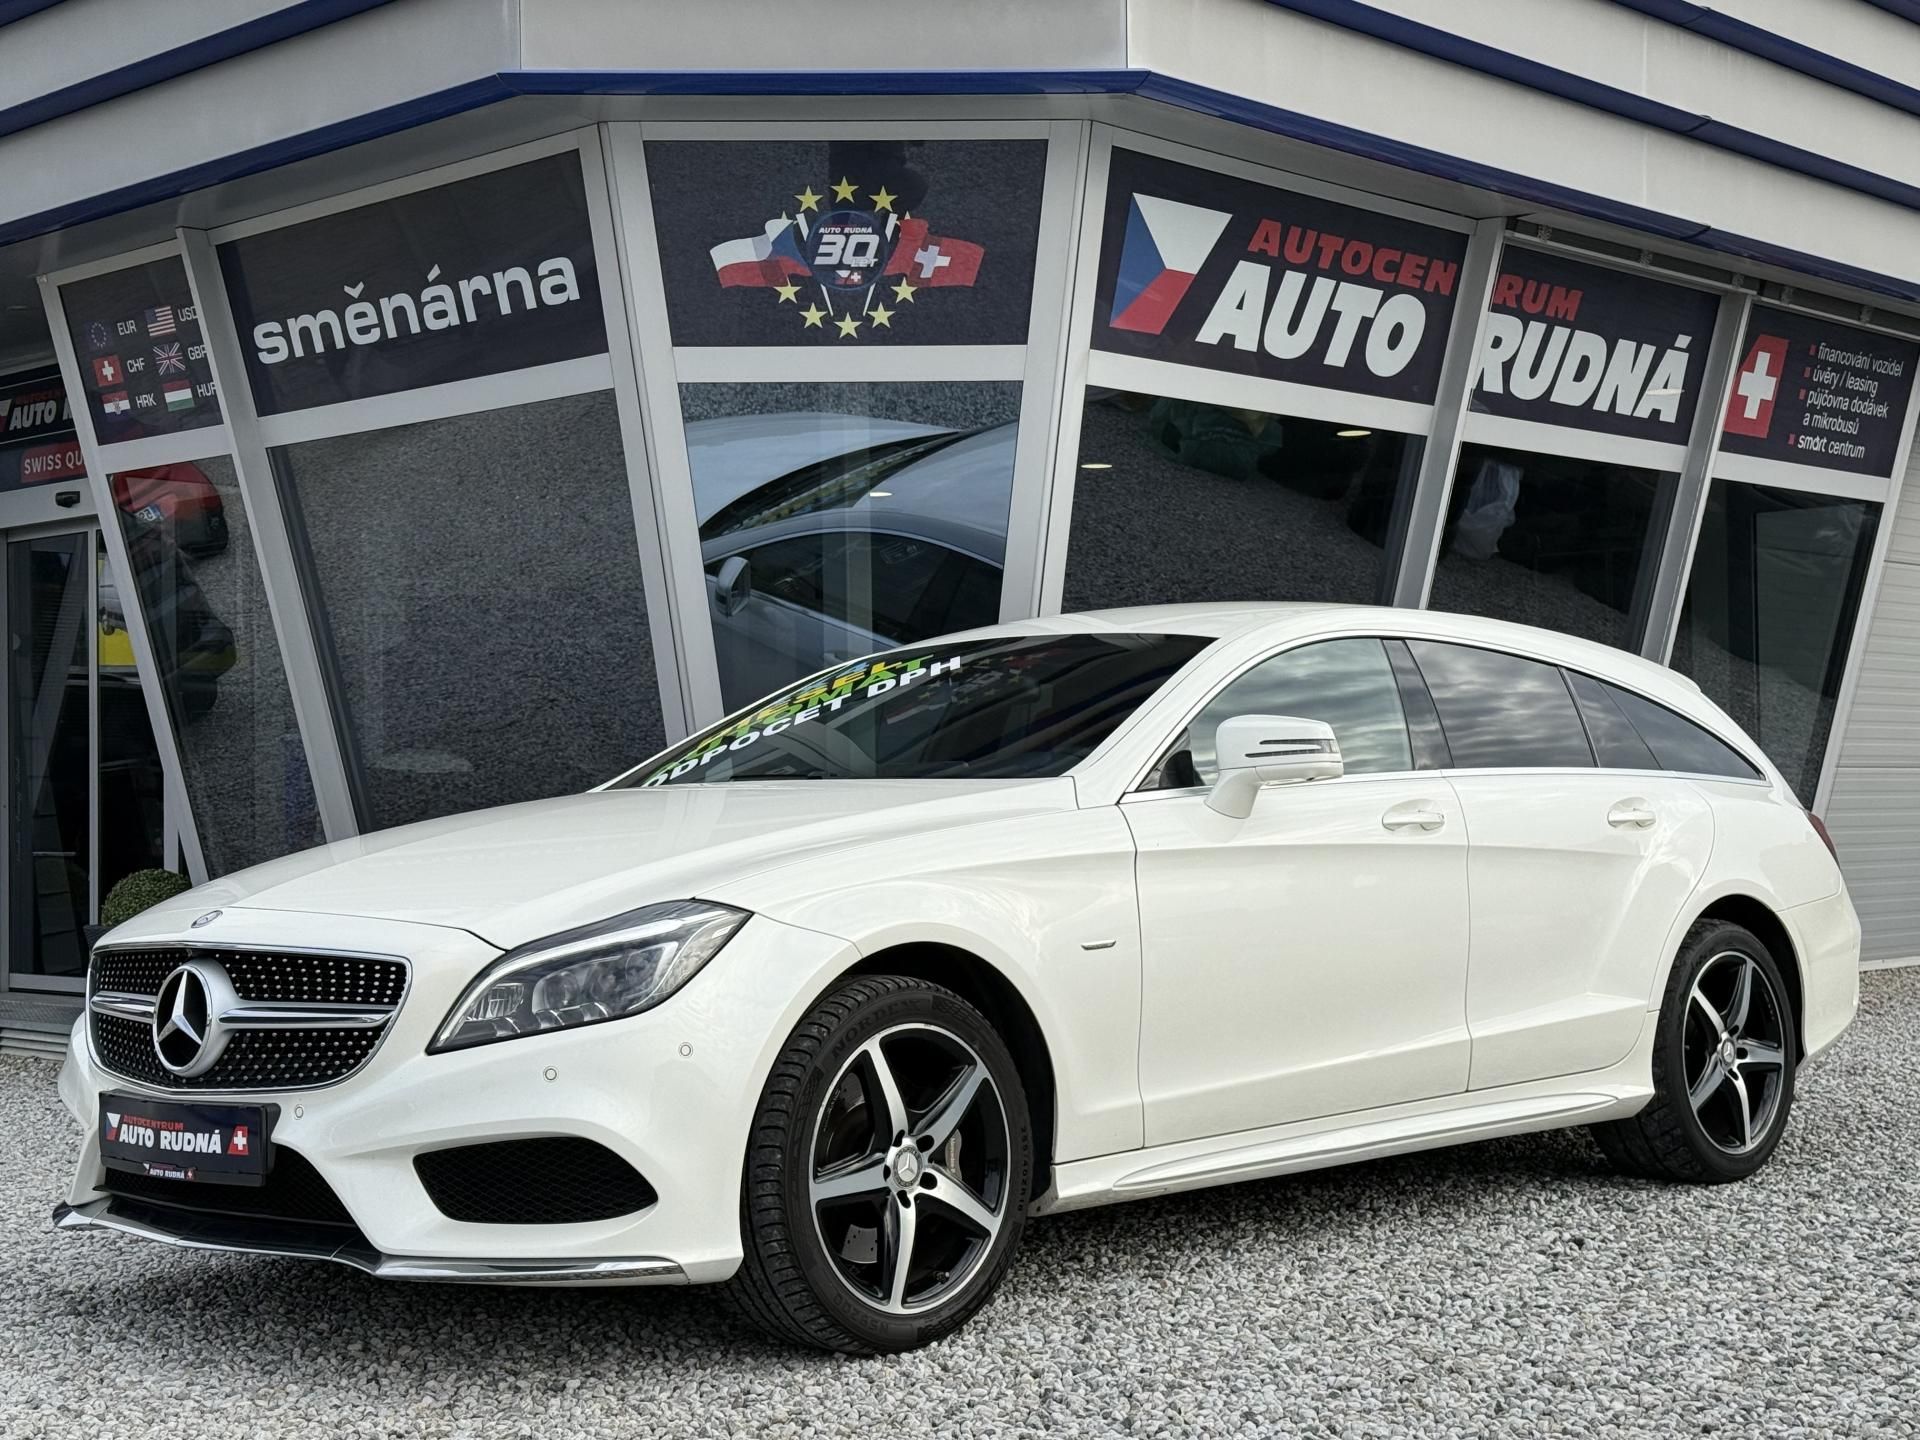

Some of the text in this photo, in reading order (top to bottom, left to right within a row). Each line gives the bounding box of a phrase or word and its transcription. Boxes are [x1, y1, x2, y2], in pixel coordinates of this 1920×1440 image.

[819, 226, 842, 234] AUTO
[813, 234, 880, 265] 30
[1248, 218, 1458, 296] AUTOCEN
[178, 305, 198, 322] USD
[253, 256, 581, 365] směnárna
[117, 320, 137, 336] EUR
[1195, 259, 1693, 425] AUTO RUDNÁ
[126, 358, 146, 373] CHF
[1818, 342, 1904, 377] financování vozidel
[1812, 365, 1840, 390] úvěry
[1846, 371, 1879, 398] leasing
[136, 393, 157, 408] HRK
[1806, 387, 1889, 418] půjčovna dodávek
[9, 400, 57, 431] AUTO
[1803, 412, 1860, 435] a mikrobusů
[1828, 440, 1866, 459] centrum
[24, 453, 62, 475] SWISS
[867, 656, 961, 698] DPH
[123, 1114, 184, 1131] AUTOCENTRUM
[119, 1123, 222, 1155] AUTO RUDNÁ
[149, 1167, 164, 1177] AUTO
